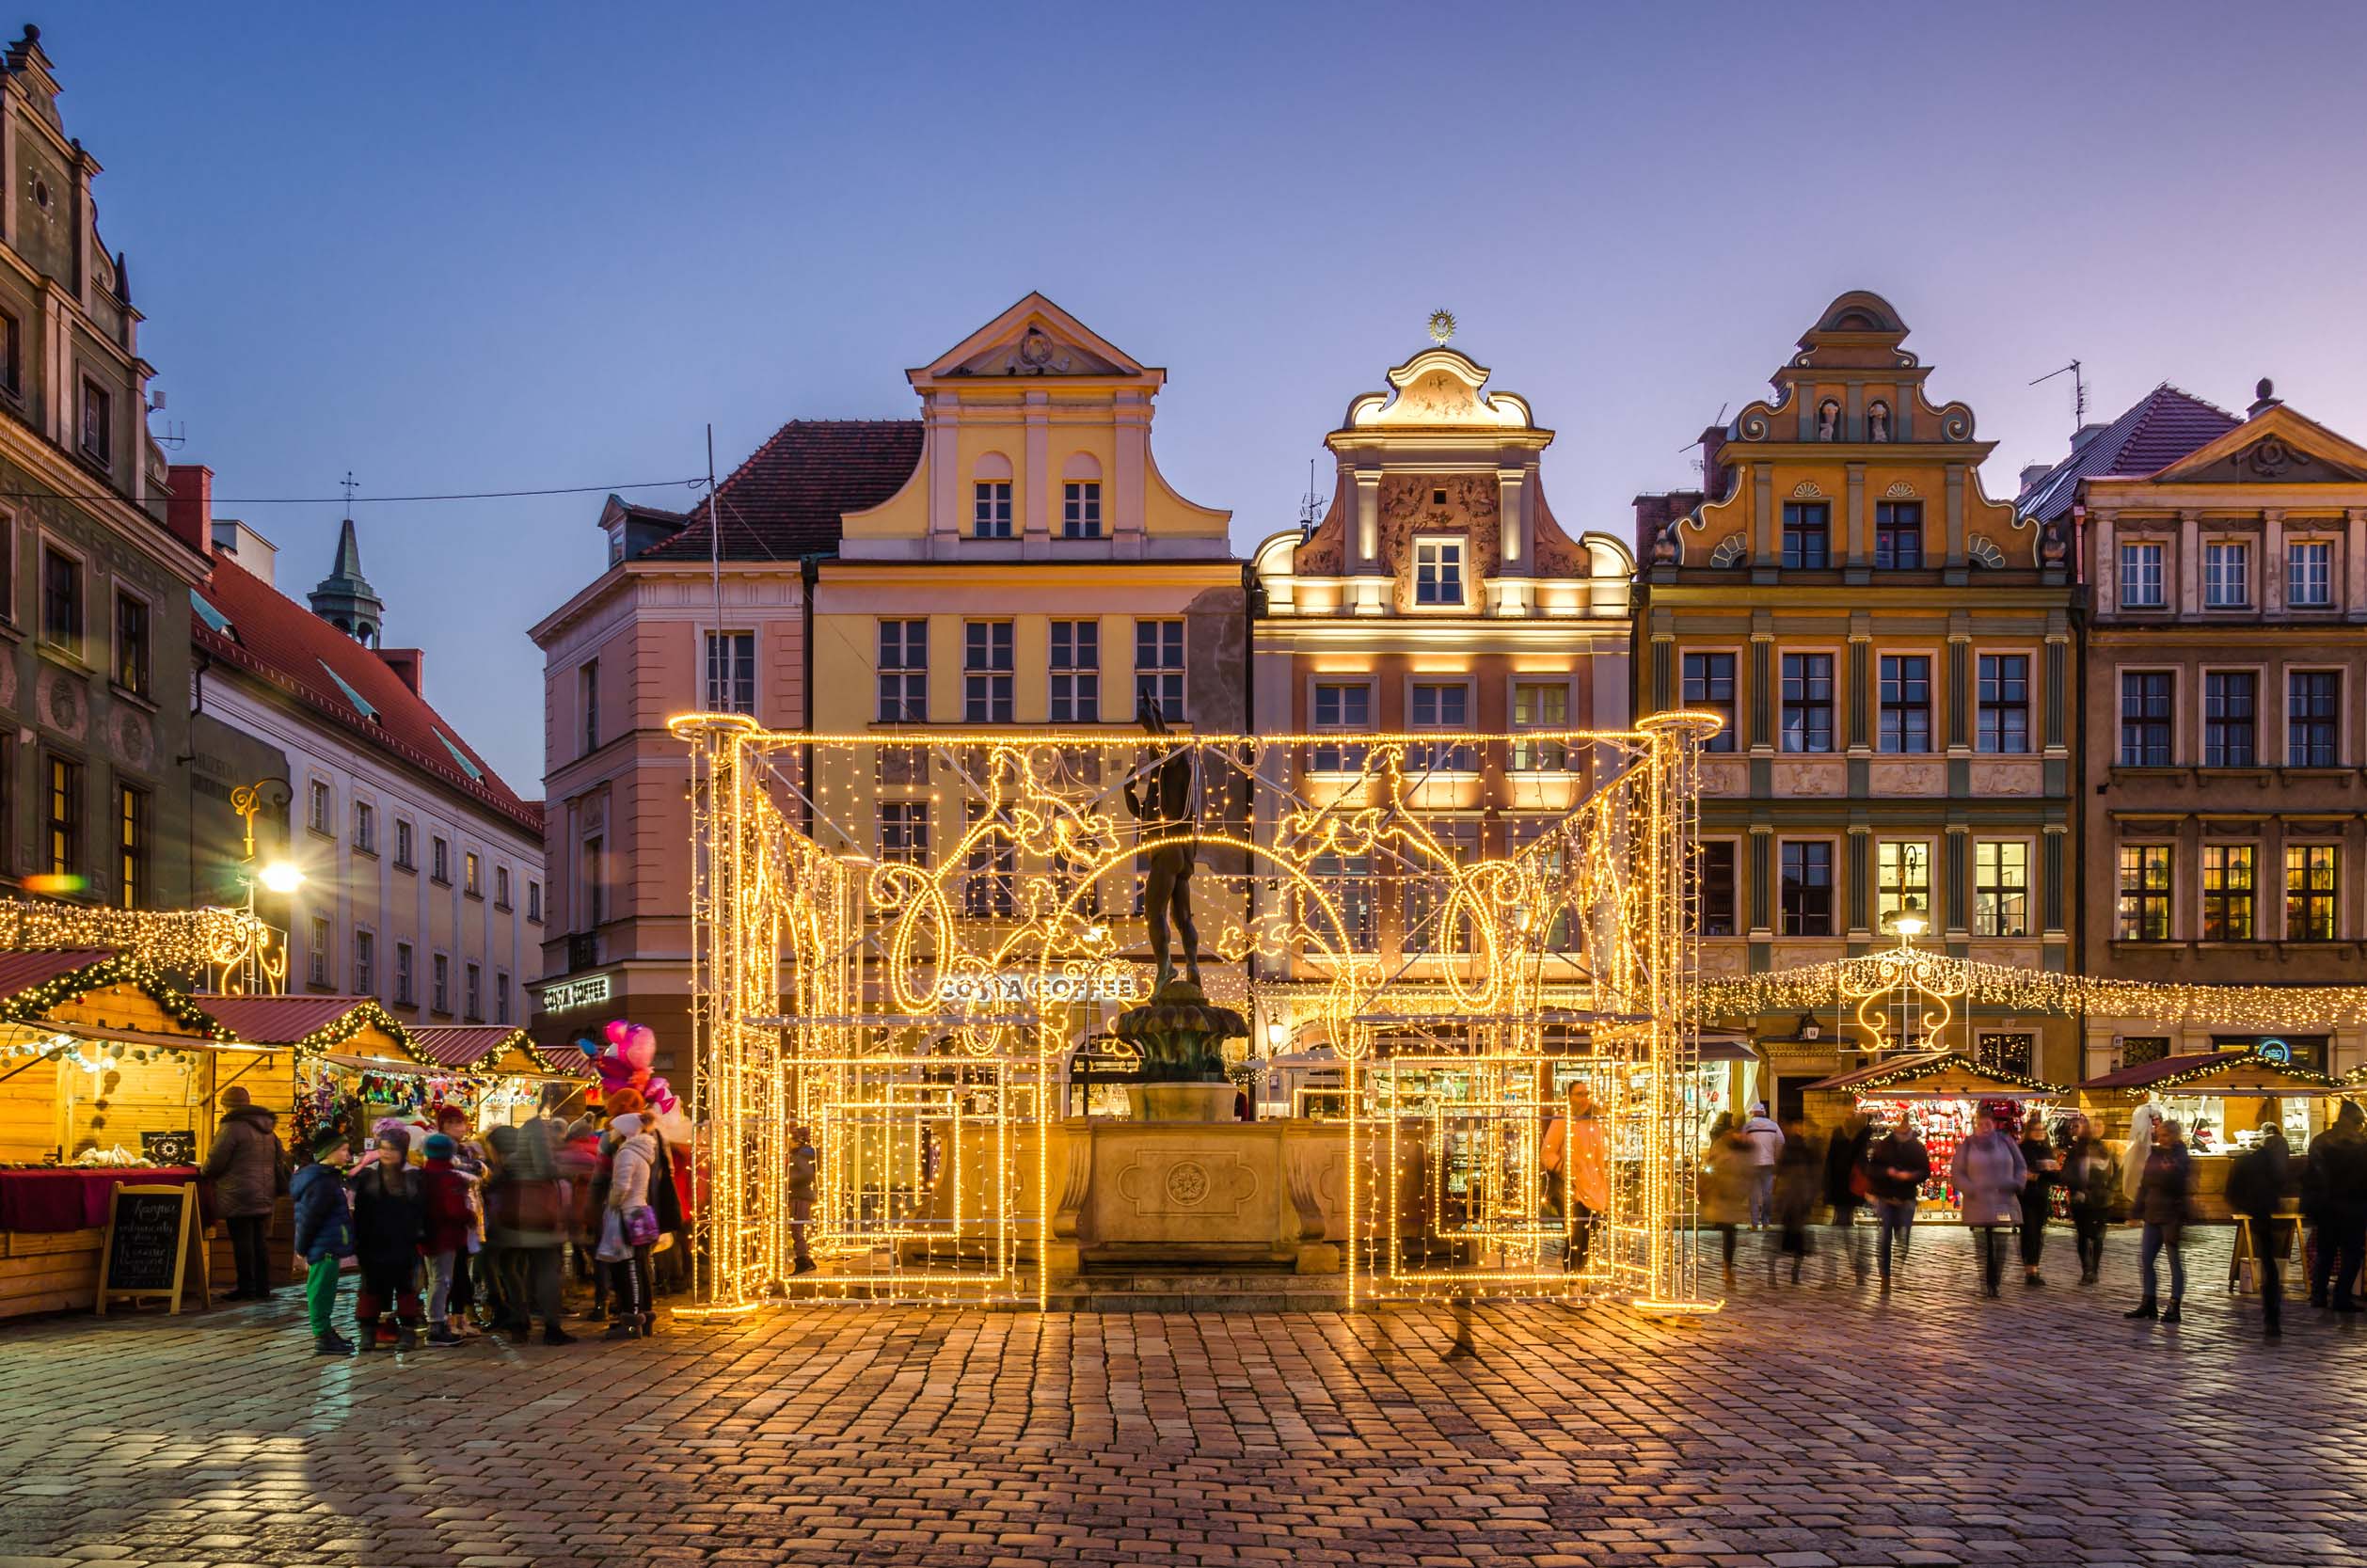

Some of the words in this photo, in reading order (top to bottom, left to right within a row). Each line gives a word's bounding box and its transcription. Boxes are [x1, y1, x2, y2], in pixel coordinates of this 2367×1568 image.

[543, 987, 573, 1009] COSTA
[573, 979, 606, 1004] COFFEE
[1035, 979, 1131, 998] COFFEE
